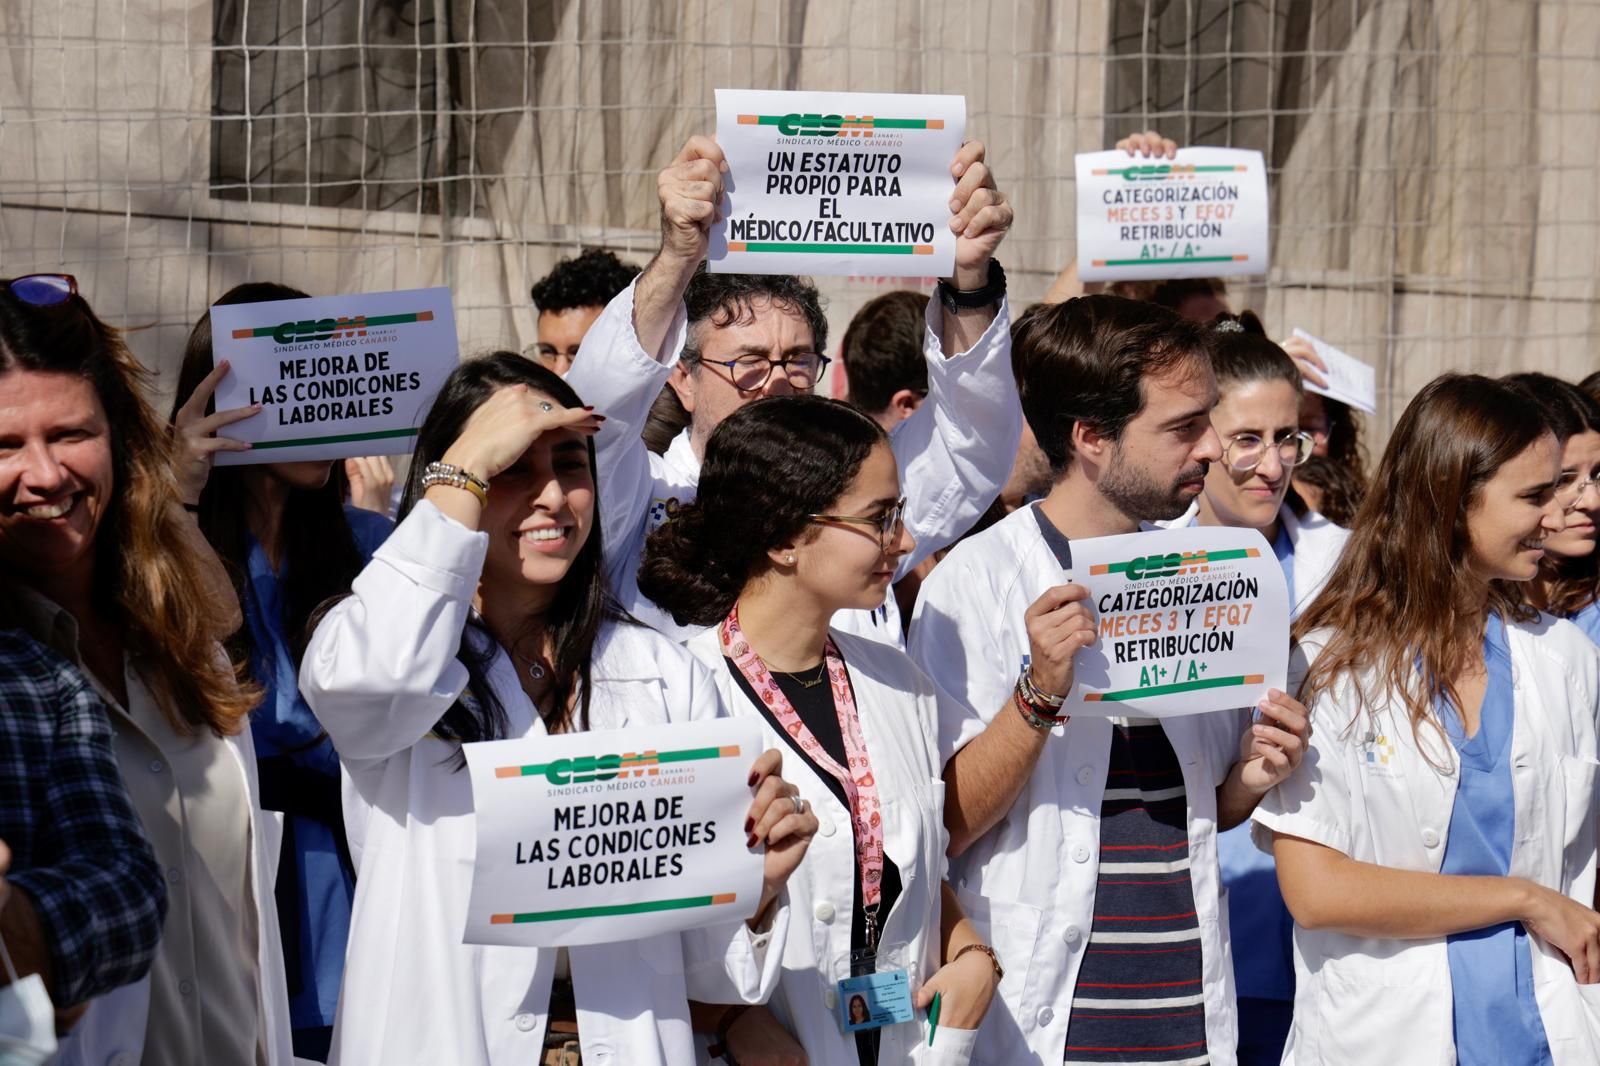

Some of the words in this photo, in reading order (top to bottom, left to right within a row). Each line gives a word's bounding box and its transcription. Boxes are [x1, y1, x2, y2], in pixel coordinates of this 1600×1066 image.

[778, 113, 874, 138] CESM
[776, 137, 824, 146] SINDICATO
[827, 137, 861, 147] MÉDICO
[863, 139, 903, 147] CANARIO
[768, 152, 795, 172] UN
[800, 153, 901, 174] ESTATUTO
[766, 174, 840, 195] PROPIO
[847, 176, 902, 197] PARA
[1103, 182, 1238, 205] CATEGORIZACIÓN
[819, 198, 842, 219] EL
[1107, 206, 1160, 223] MECES
[1165, 206, 1173, 221] 3
[1178, 206, 1187, 220] Y
[1196, 204, 1235, 220] EFQ7
[730, 213, 934, 243] MÉDICO/FACULTATIVO
[1120, 217, 1222, 241] RETRIBUCIÓN
[1140, 243, 1165, 259] A1+
[1170, 242, 1178, 257] /
[1183, 243, 1202, 258] A+
[273, 343, 320, 354] SINDICATO
[323, 339, 357, 349] MÉDICO
[359, 335, 398, 345] CANARIO
[279, 355, 359, 380] MEJORA
[365, 351, 390, 371] DE
[250, 385, 288, 405] LAS
[293, 371, 420, 401] CONDICONES
[279, 397, 393, 426] LABORALES
[1125, 550, 1209, 581] CESM
[1099, 572, 1259, 614] CATEGORIZACIÓN
[1124, 579, 1166, 590] SINDICATO
[1169, 576, 1200, 586] MÉDICO
[1202, 572, 1236, 582] CANARIO
[1100, 612, 1164, 639] MECES
[1168, 611, 1178, 631] 3
[1185, 609, 1196, 629] Y
[1204, 604, 1251, 627] EFQ7
[1115, 626, 1234, 663] RETRIBUCIÓN
[1139, 664, 1167, 687] A1+
[1173, 660, 1182, 683] /
[1187, 660, 1208, 681] A+
[545, 750, 659, 786] CESM
[547, 784, 603, 797] SINDICATO
[607, 780, 647, 792] MÉDICO
[650, 775, 695, 788] CANARIO
[554, 800, 646, 831] MEJORA
[654, 796, 684, 819] DE
[516, 838, 560, 865] LAS
[568, 821, 716, 859] CONDICONES
[547, 853, 684, 890] LABORALES
